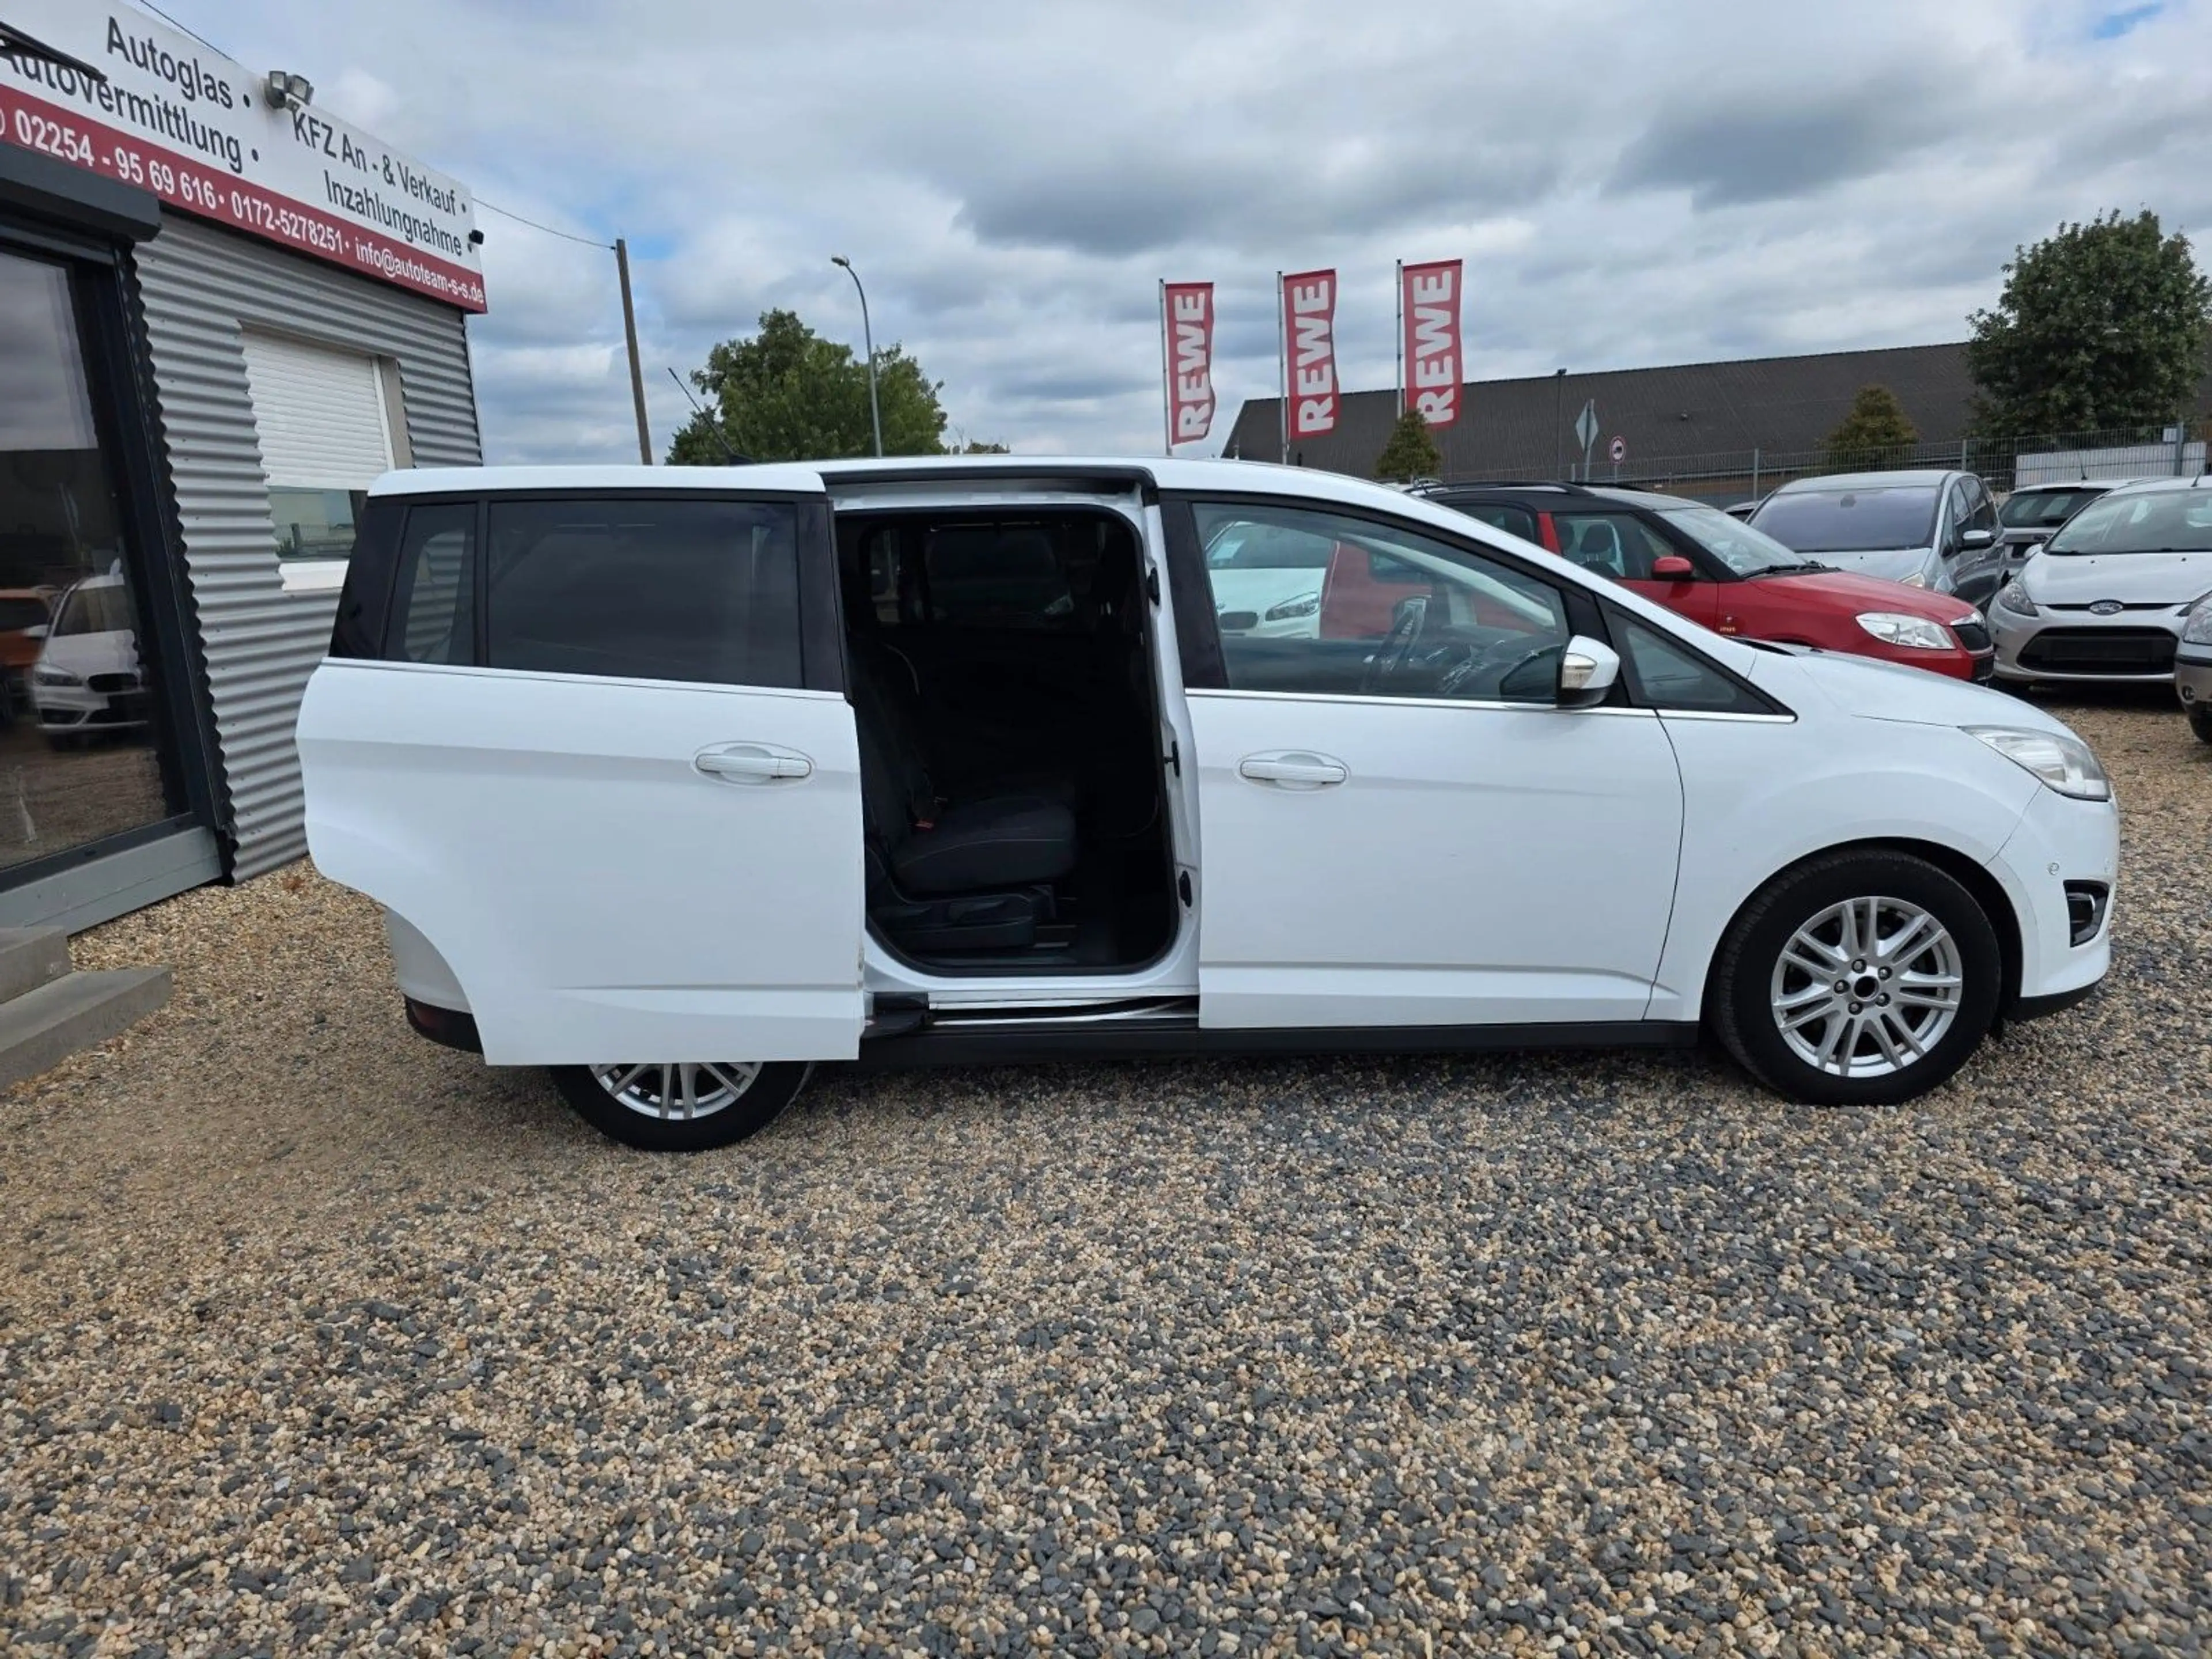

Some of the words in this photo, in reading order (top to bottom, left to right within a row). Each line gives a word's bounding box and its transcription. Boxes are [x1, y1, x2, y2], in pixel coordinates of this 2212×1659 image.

[107, 16, 233, 109] Autoglas
[291, 111, 337, 160] KFZ
[342, 133, 367, 172] An
[382, 154, 396, 187] &
[397, 161, 456, 216] Verkauf
[15, 109, 95, 167] 02254
[115, 147, 144, 184] 95
[149, 160, 175, 195] 69
[180, 172, 217, 210] 616
[232, 191, 343, 255] 0172-5278251
[355, 236, 484, 304] info@autoteam-s-s.de
[324, 170, 461, 256] Inzahlungnahme
[1174, 290, 1210, 437] REWE
[1293, 280, 1334, 433] REWE
[1412, 270, 1455, 423] REWE
